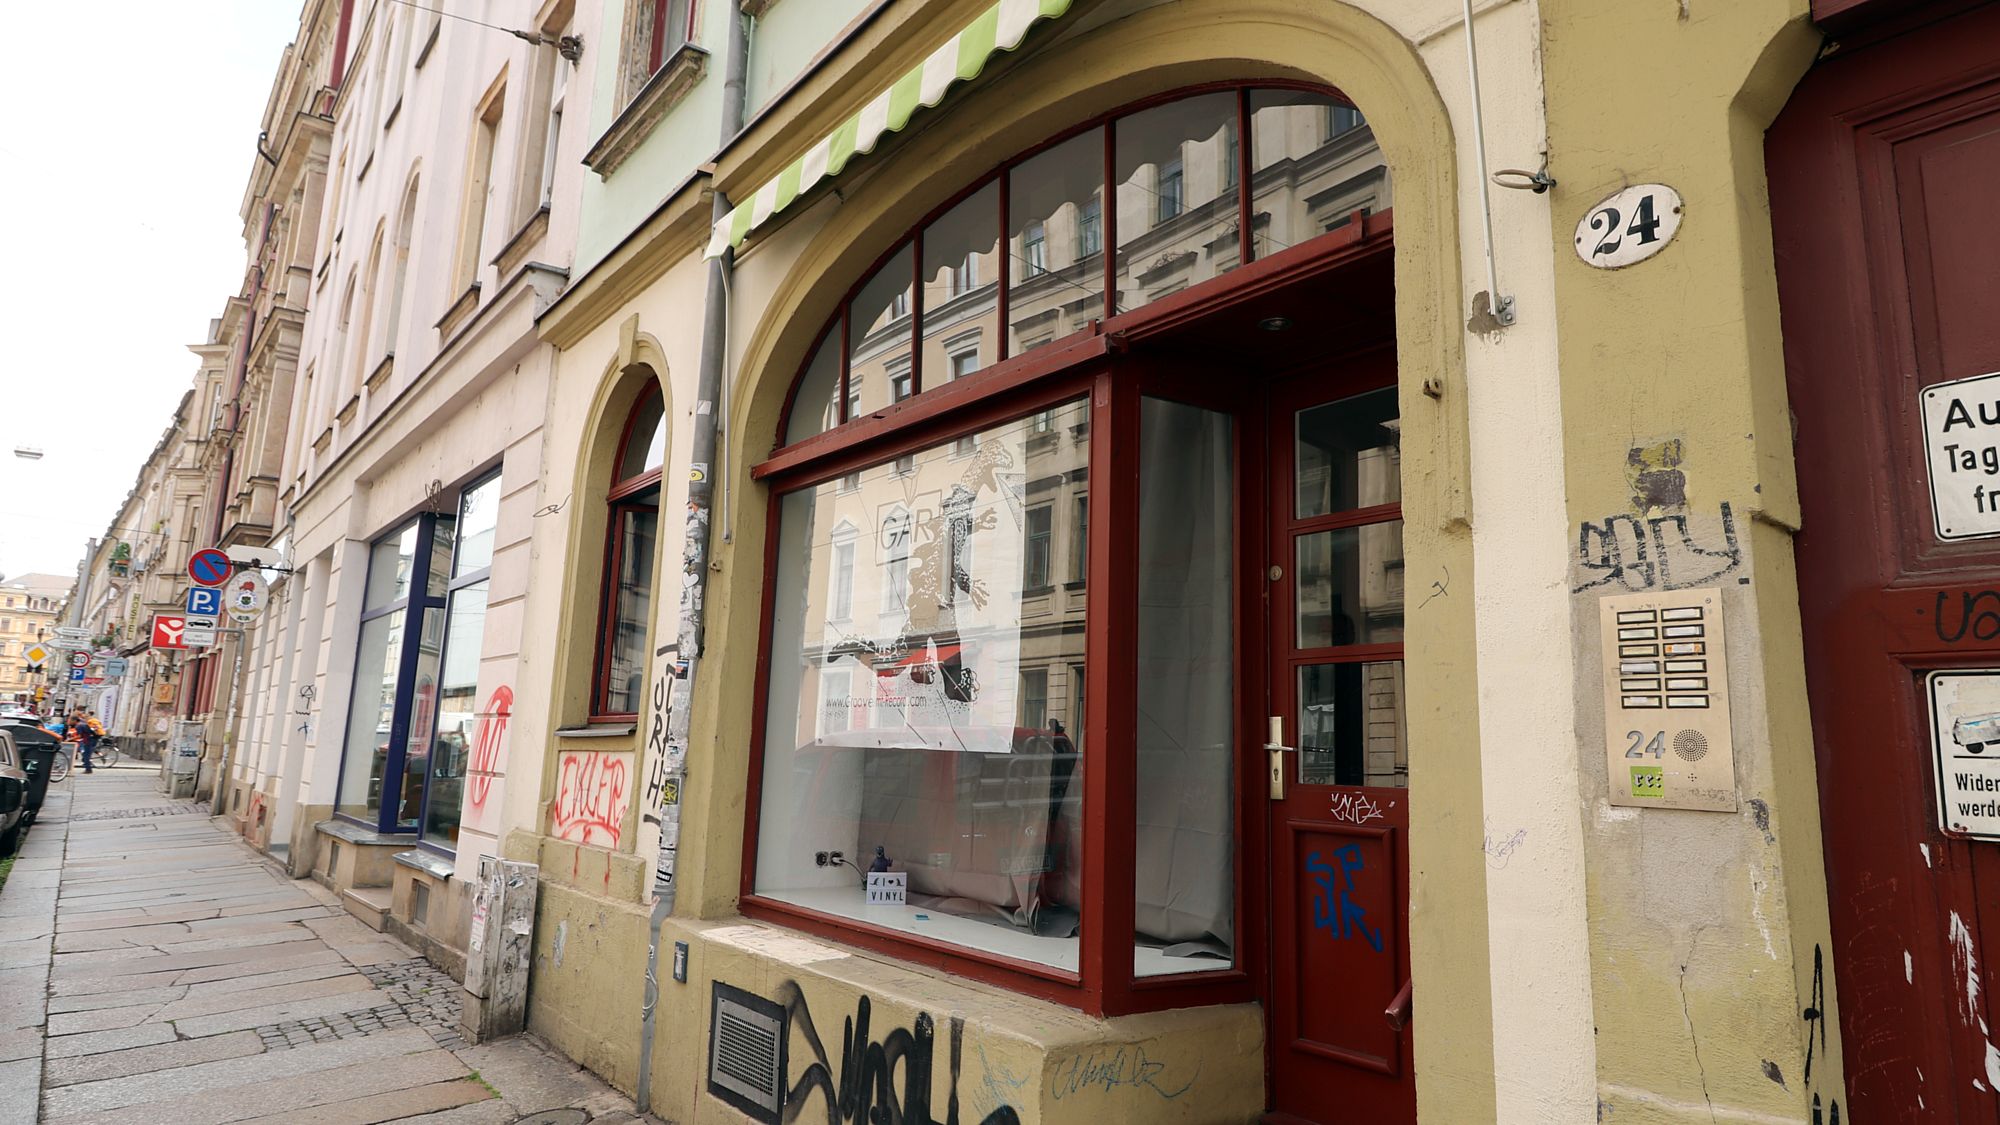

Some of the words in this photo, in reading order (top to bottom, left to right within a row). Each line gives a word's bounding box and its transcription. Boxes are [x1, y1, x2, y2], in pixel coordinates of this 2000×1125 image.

[1590, 194, 1660, 259] 24
[1942, 398, 2000, 433] Au
[1943, 443, 1999, 475] Tag
[191, 590, 212, 611] P
[126, 592, 141, 641] HOSTEL
[73, 655, 85, 665] 30
[72, 669, 82, 680] P
[1625, 730, 1666, 759] 24
[1955, 773, 2000, 792] Wider
[871, 891, 904, 901] VINYL
